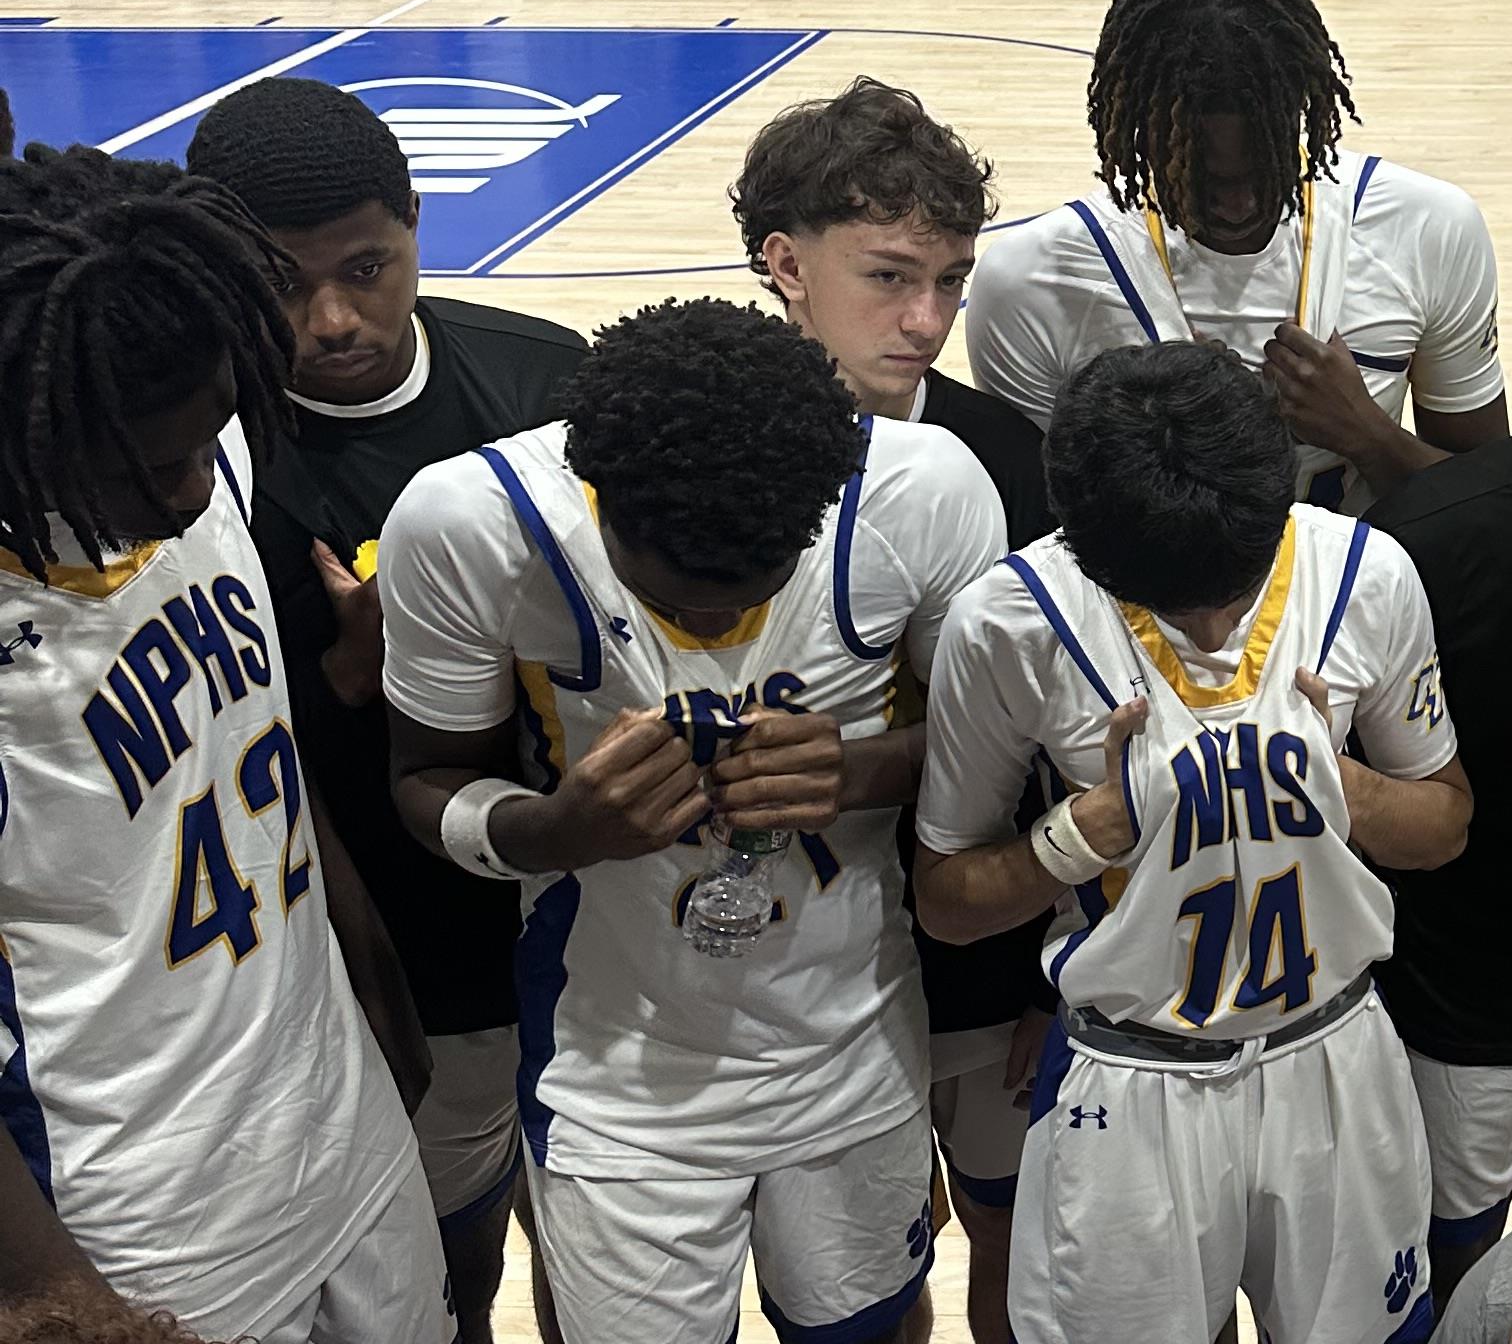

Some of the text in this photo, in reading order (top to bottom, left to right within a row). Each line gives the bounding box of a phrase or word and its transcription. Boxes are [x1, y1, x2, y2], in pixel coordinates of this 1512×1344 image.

[81, 574, 272, 822] NPHS
[164, 715, 314, 972] 42
[1170, 860, 1319, 1030] 14
